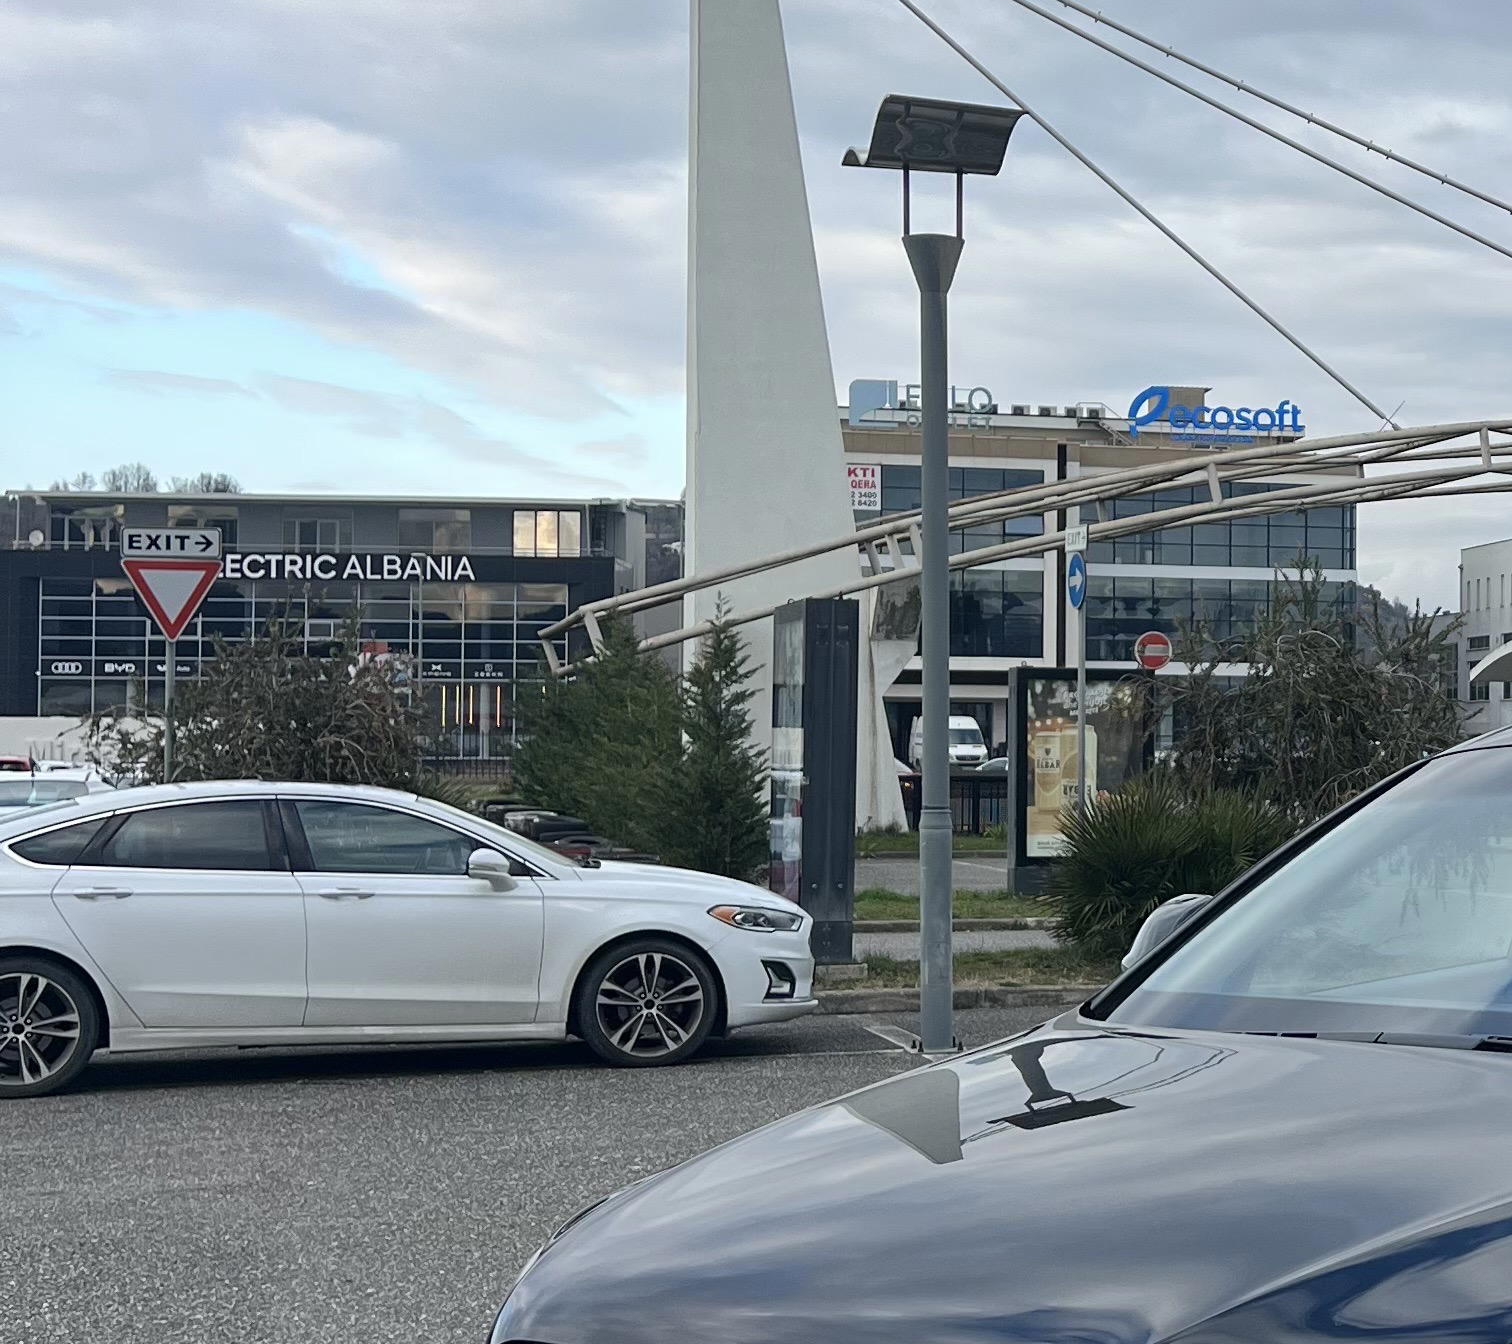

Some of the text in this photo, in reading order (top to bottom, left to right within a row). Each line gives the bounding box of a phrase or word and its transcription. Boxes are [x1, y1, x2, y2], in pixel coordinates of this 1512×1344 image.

[1169, 400, 1304, 432] ecosoft
[128, 534, 191, 550] EXIT
[218, 553, 475, 581] ECTRIC ALBANIA
